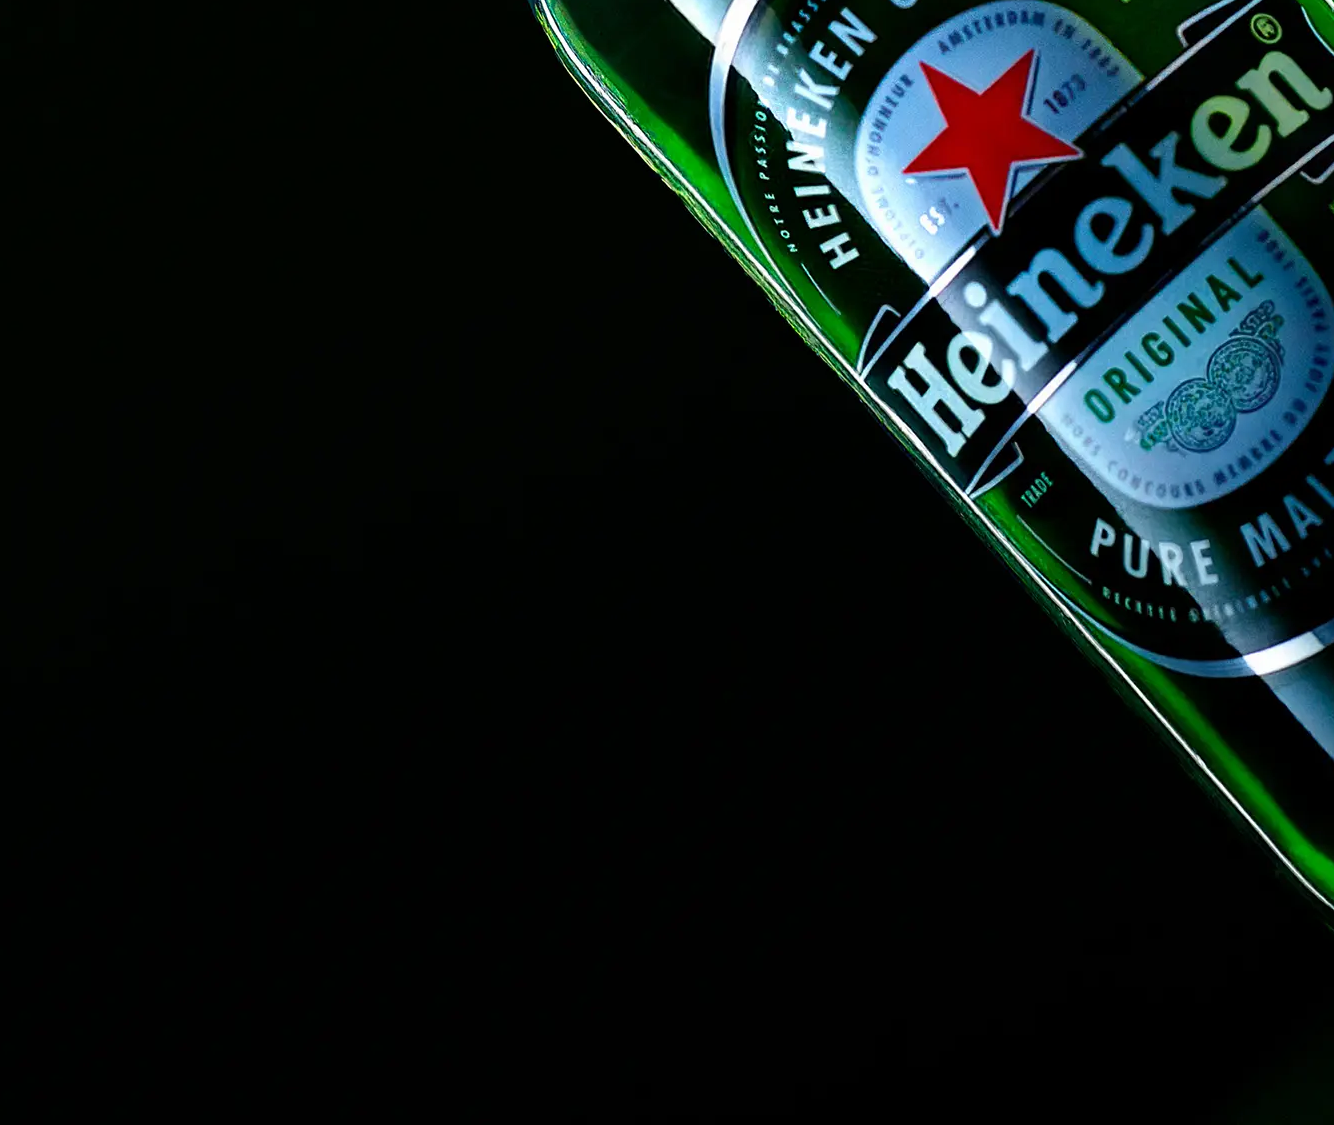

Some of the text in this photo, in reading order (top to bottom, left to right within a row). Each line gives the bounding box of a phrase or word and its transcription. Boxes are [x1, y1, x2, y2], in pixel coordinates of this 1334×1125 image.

[1043, 73, 1087, 115] 1873
[785, 6, 879, 270] HEINEKEN
[764, 192, 799, 253] NOTRE
[887, 50, 1334, 457] Heineken
[1083, 256, 1265, 424] ORIGINAL
[1020, 470, 1055, 509] TRADE
[1089, 517, 1220, 589] PURE
